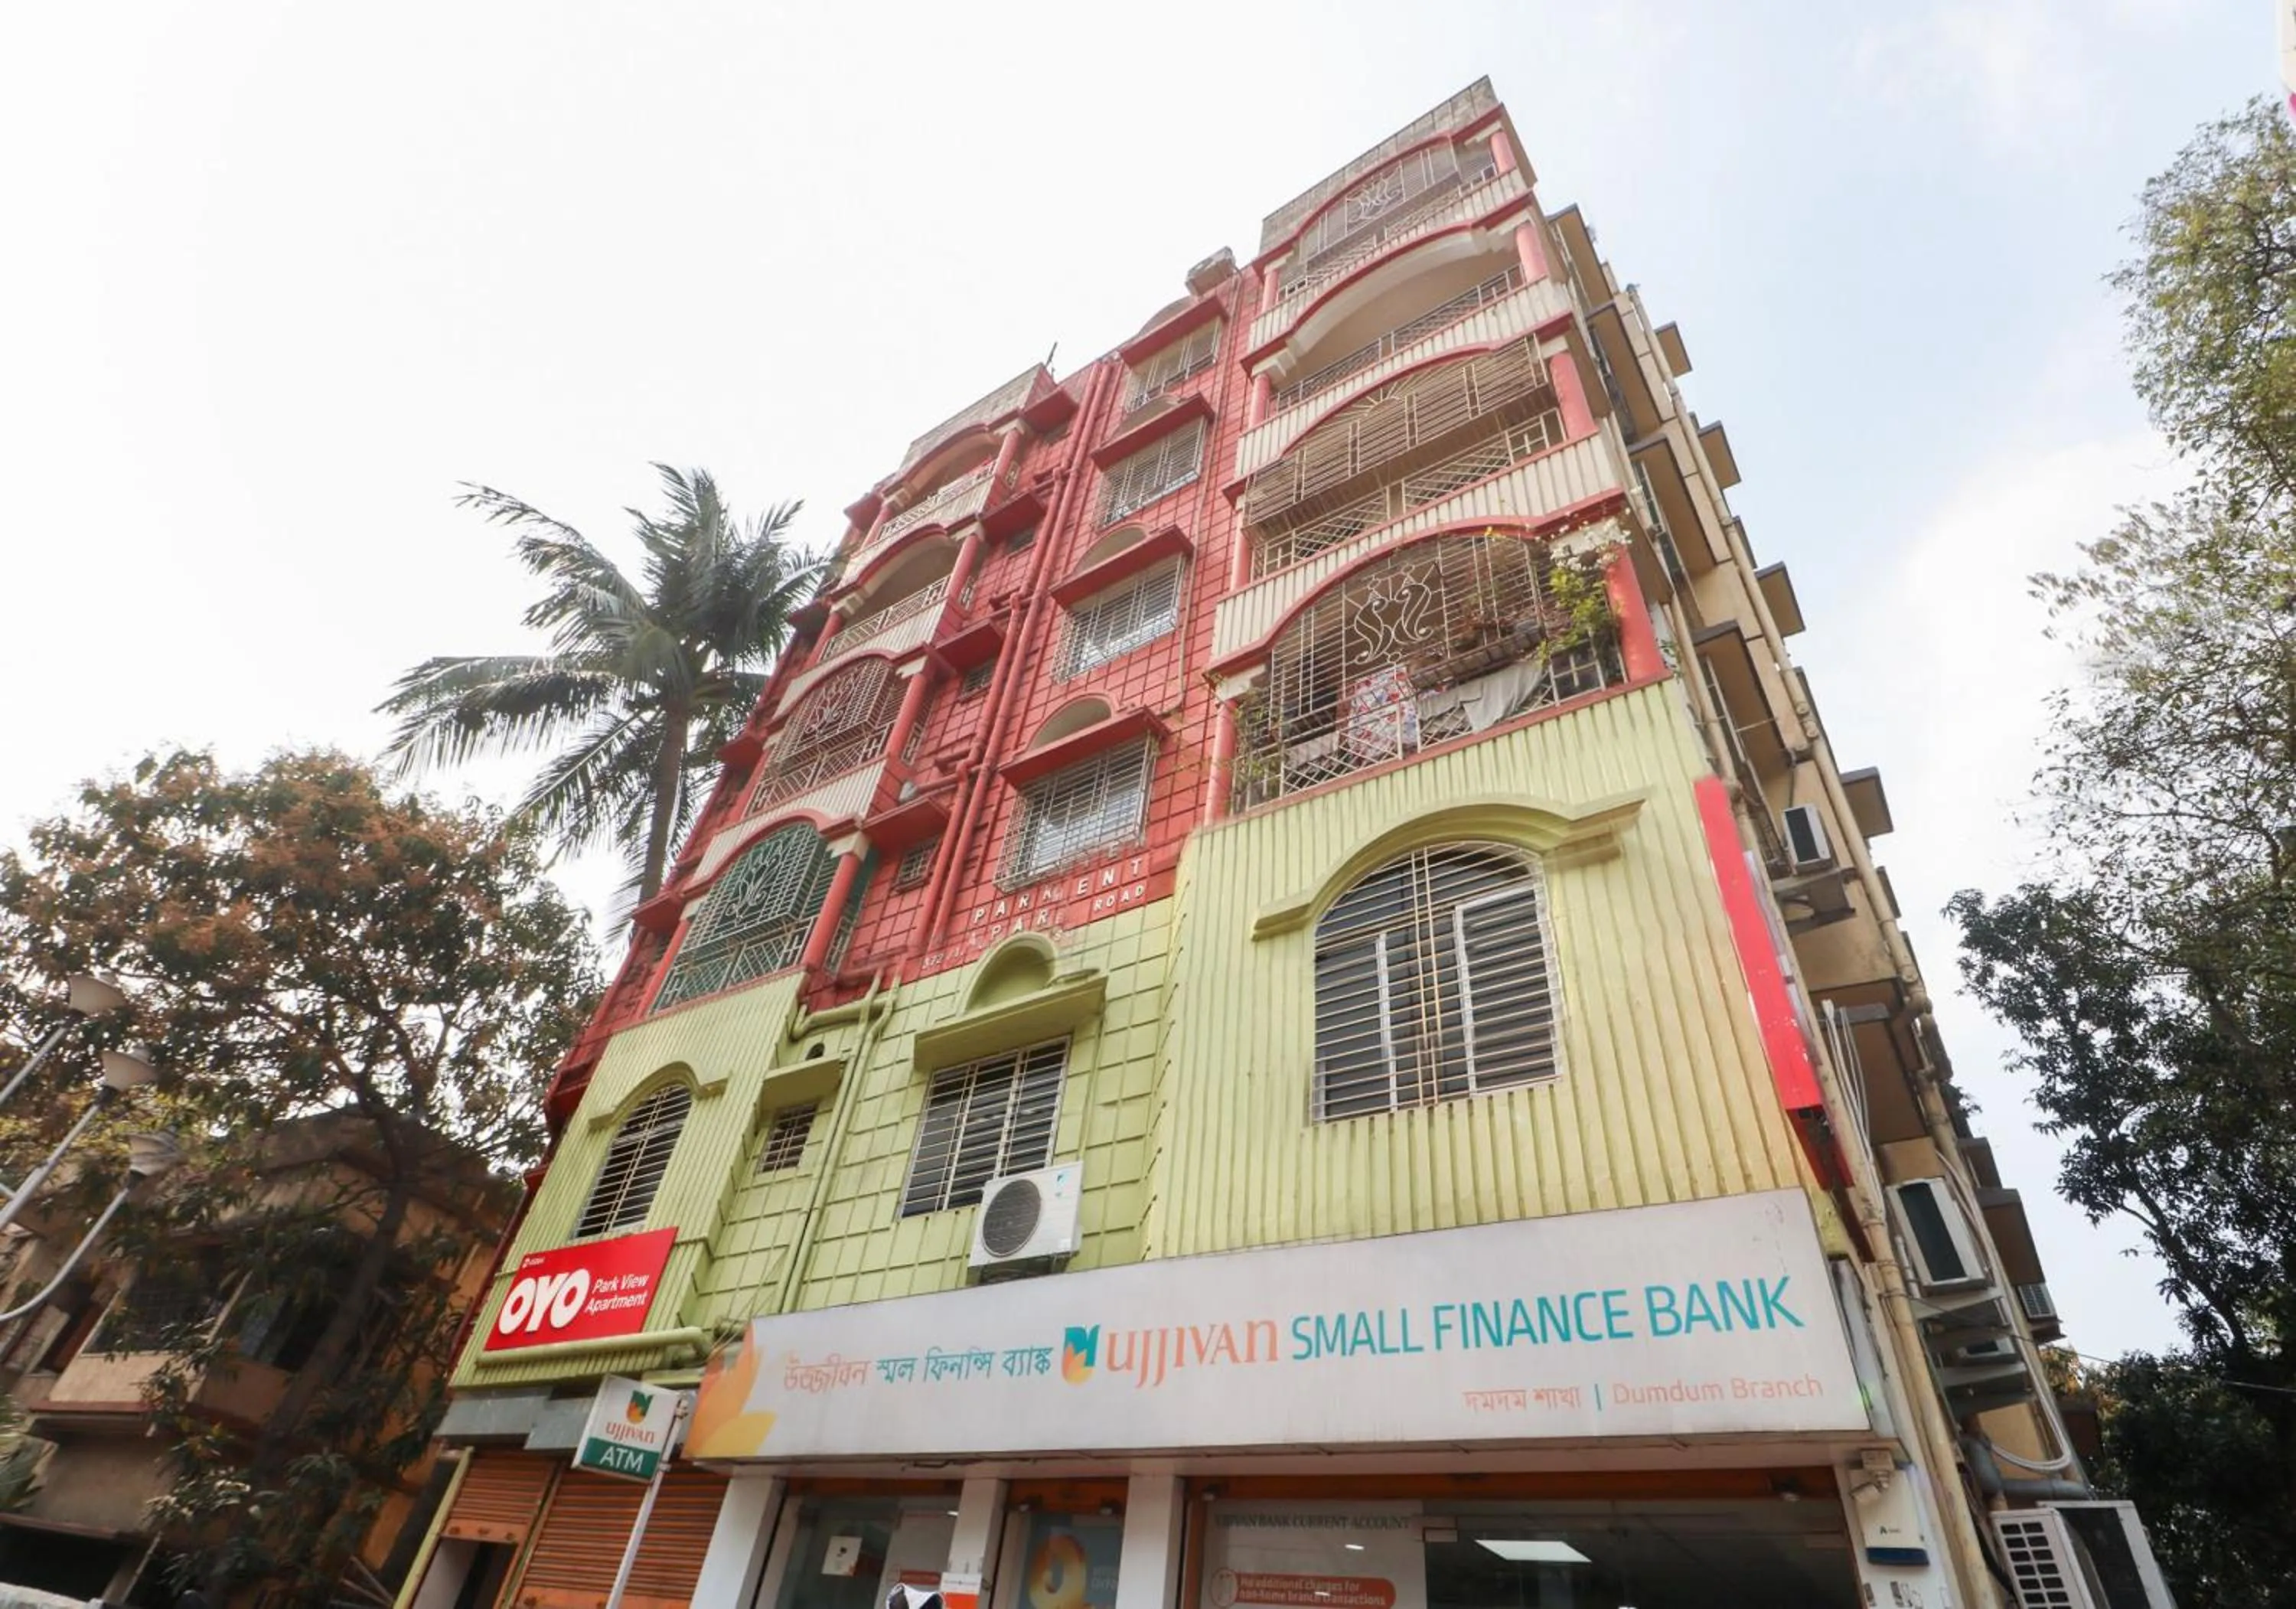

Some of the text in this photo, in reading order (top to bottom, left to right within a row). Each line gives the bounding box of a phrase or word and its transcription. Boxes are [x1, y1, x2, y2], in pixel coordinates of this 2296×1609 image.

[1094, 885, 1144, 912] ROAD
[498, 1268, 649, 1335] OYO Park View
[585, 1291, 648, 1315] Apartment
[1293, 1308, 1423, 1360] SMALL
[1433, 1290, 1633, 1350] FINANCE
[1644, 1275, 1804, 1337] BANK
[1613, 1373, 1824, 1405] Dumdum Branch
[599, 1445, 645, 1473] ATM
